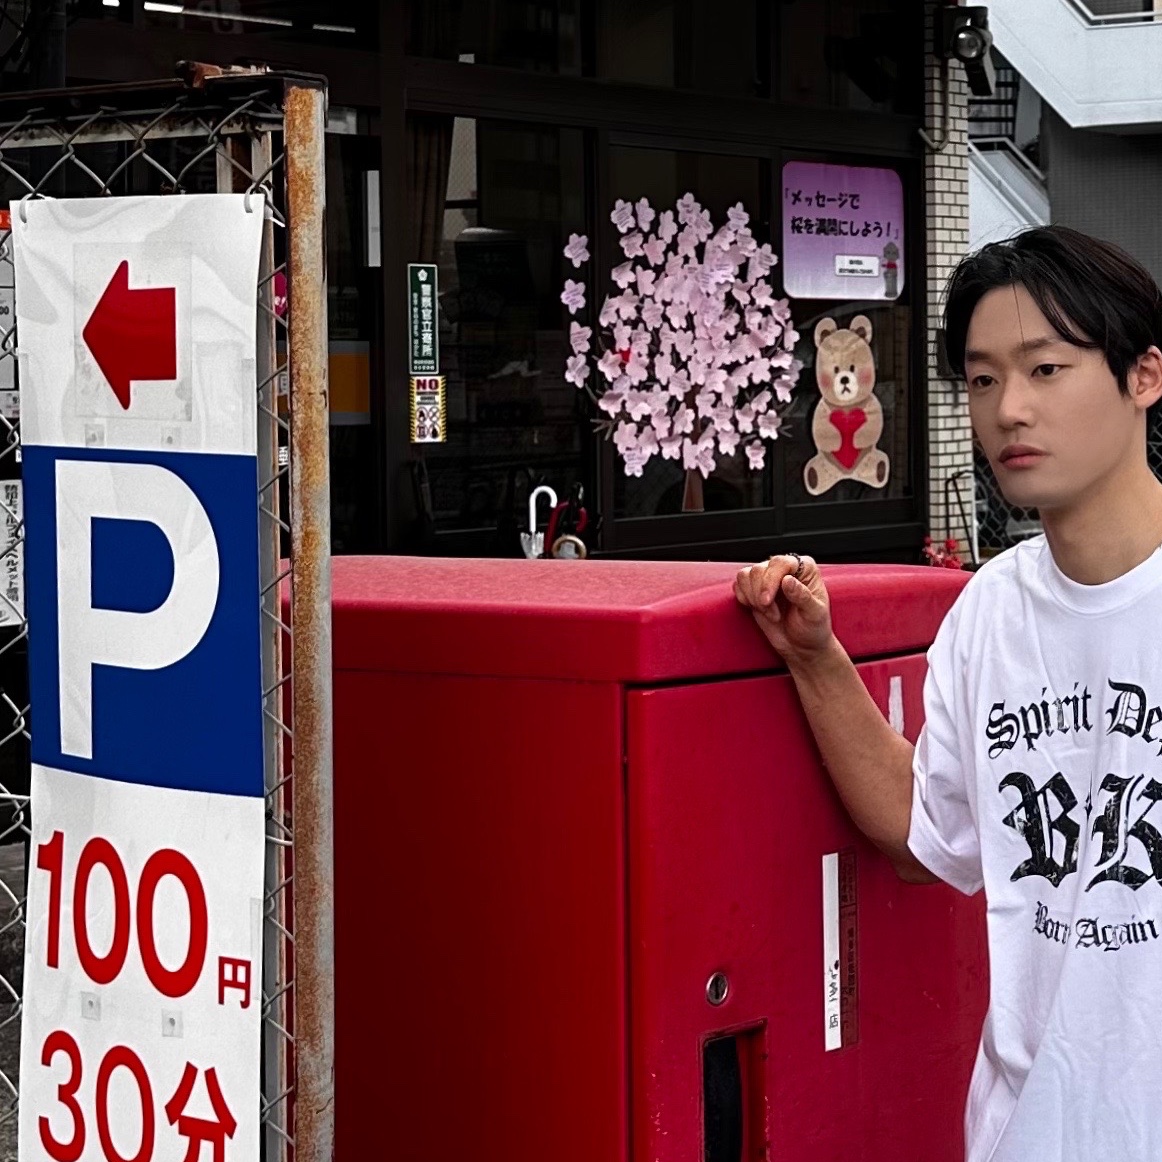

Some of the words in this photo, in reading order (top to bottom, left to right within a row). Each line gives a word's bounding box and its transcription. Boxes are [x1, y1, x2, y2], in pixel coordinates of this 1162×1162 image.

[416, 379, 439, 390] NO
[55, 459, 220, 760] P
[985, 681, 1093, 760] Spirit
[36, 830, 253, 1010] 100円
[1075, 914, 1160, 952] Again
